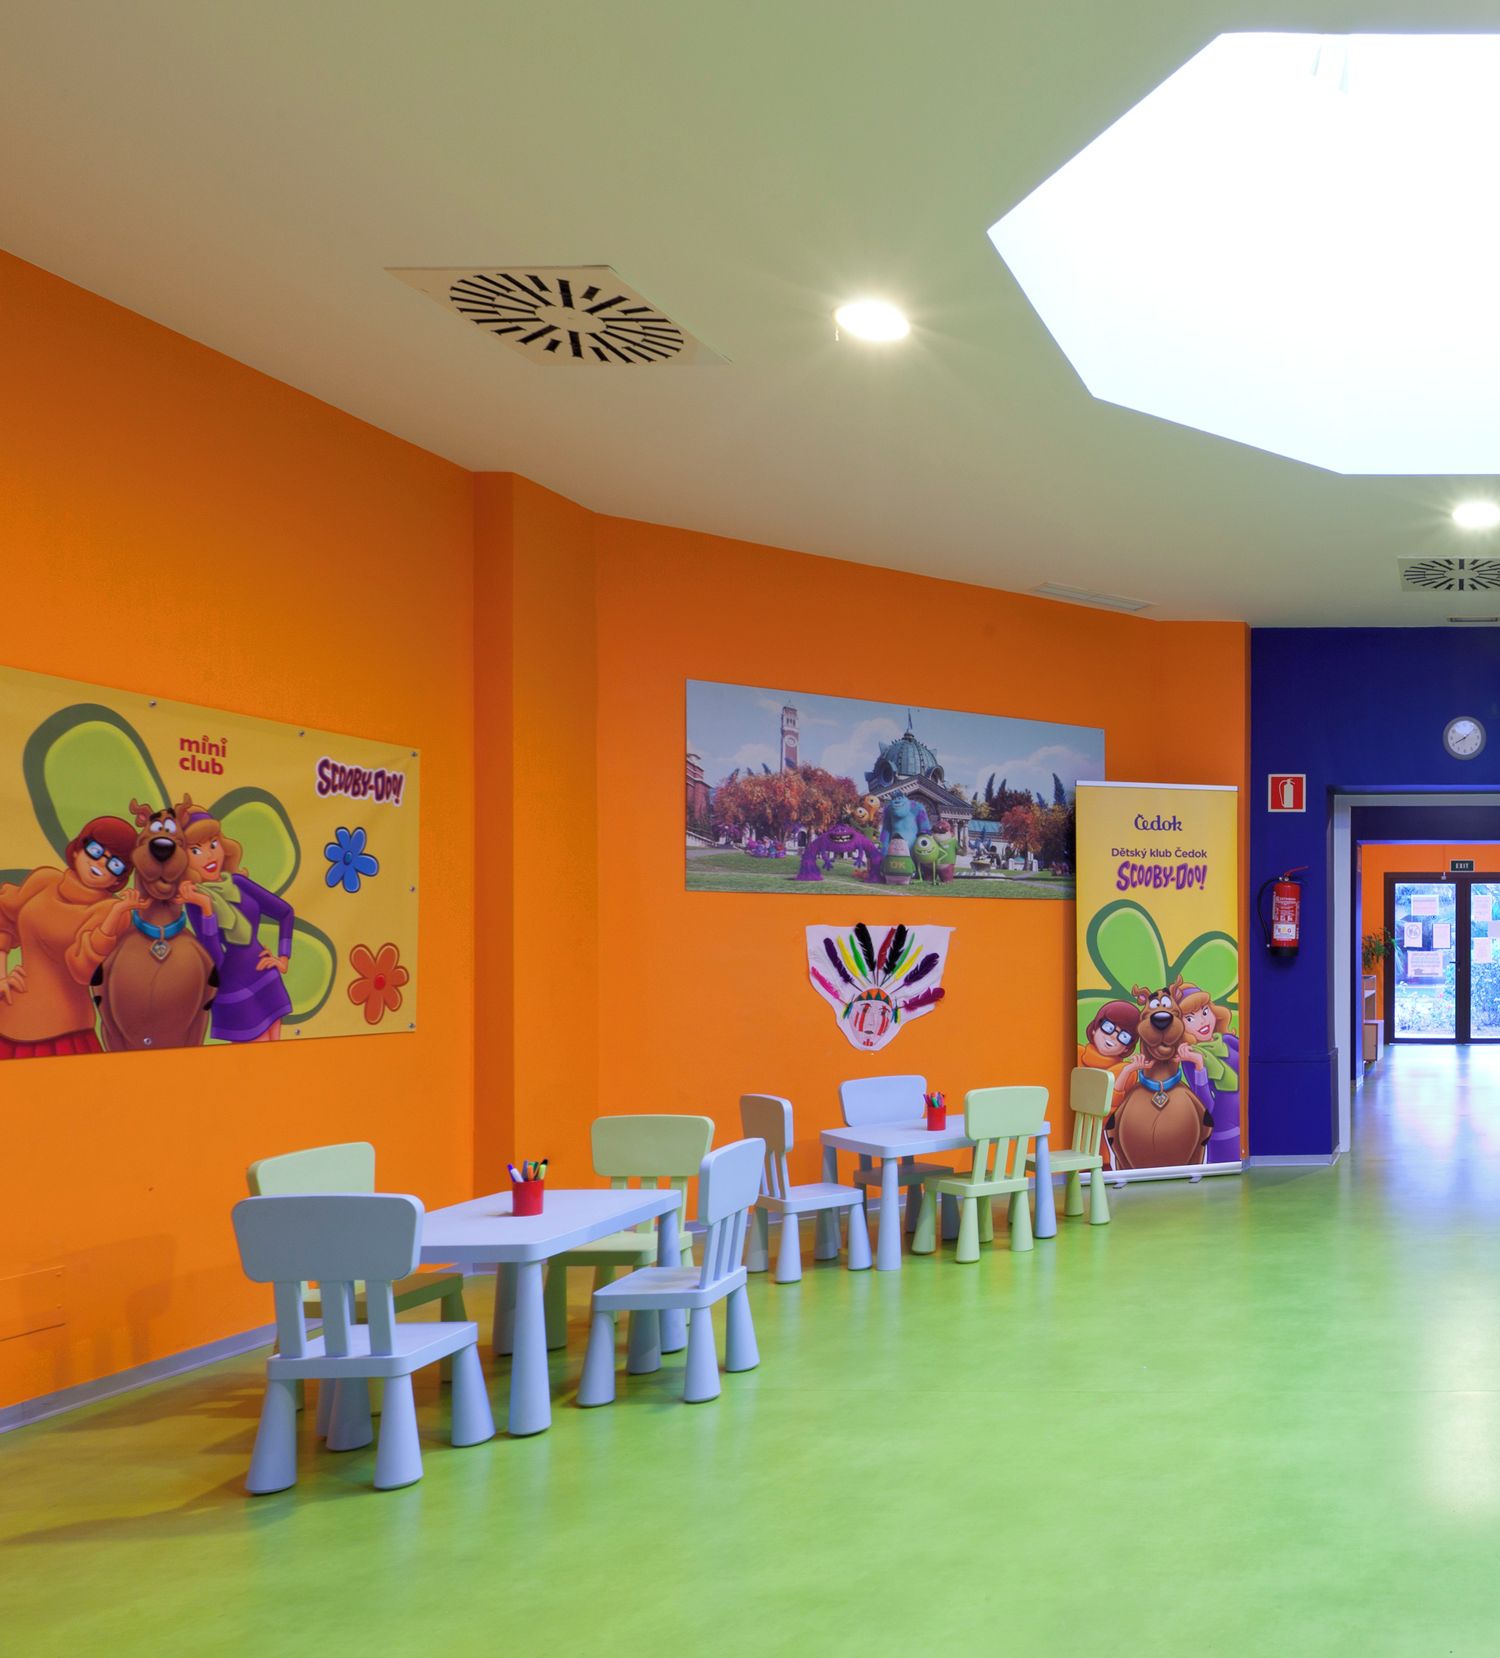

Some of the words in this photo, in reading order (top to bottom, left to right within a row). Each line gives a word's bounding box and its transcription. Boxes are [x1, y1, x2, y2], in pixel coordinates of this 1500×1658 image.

[179, 735, 228, 758] mini
[179, 755, 224, 776] club
[1134, 813, 1183, 831] Čedok
[1111, 848, 1147, 859] Dětský
[1149, 848, 1173, 858] klub
[1174, 847, 1208, 858] Čedok
[1116, 860, 1208, 892] SCOOBY-DOO!
